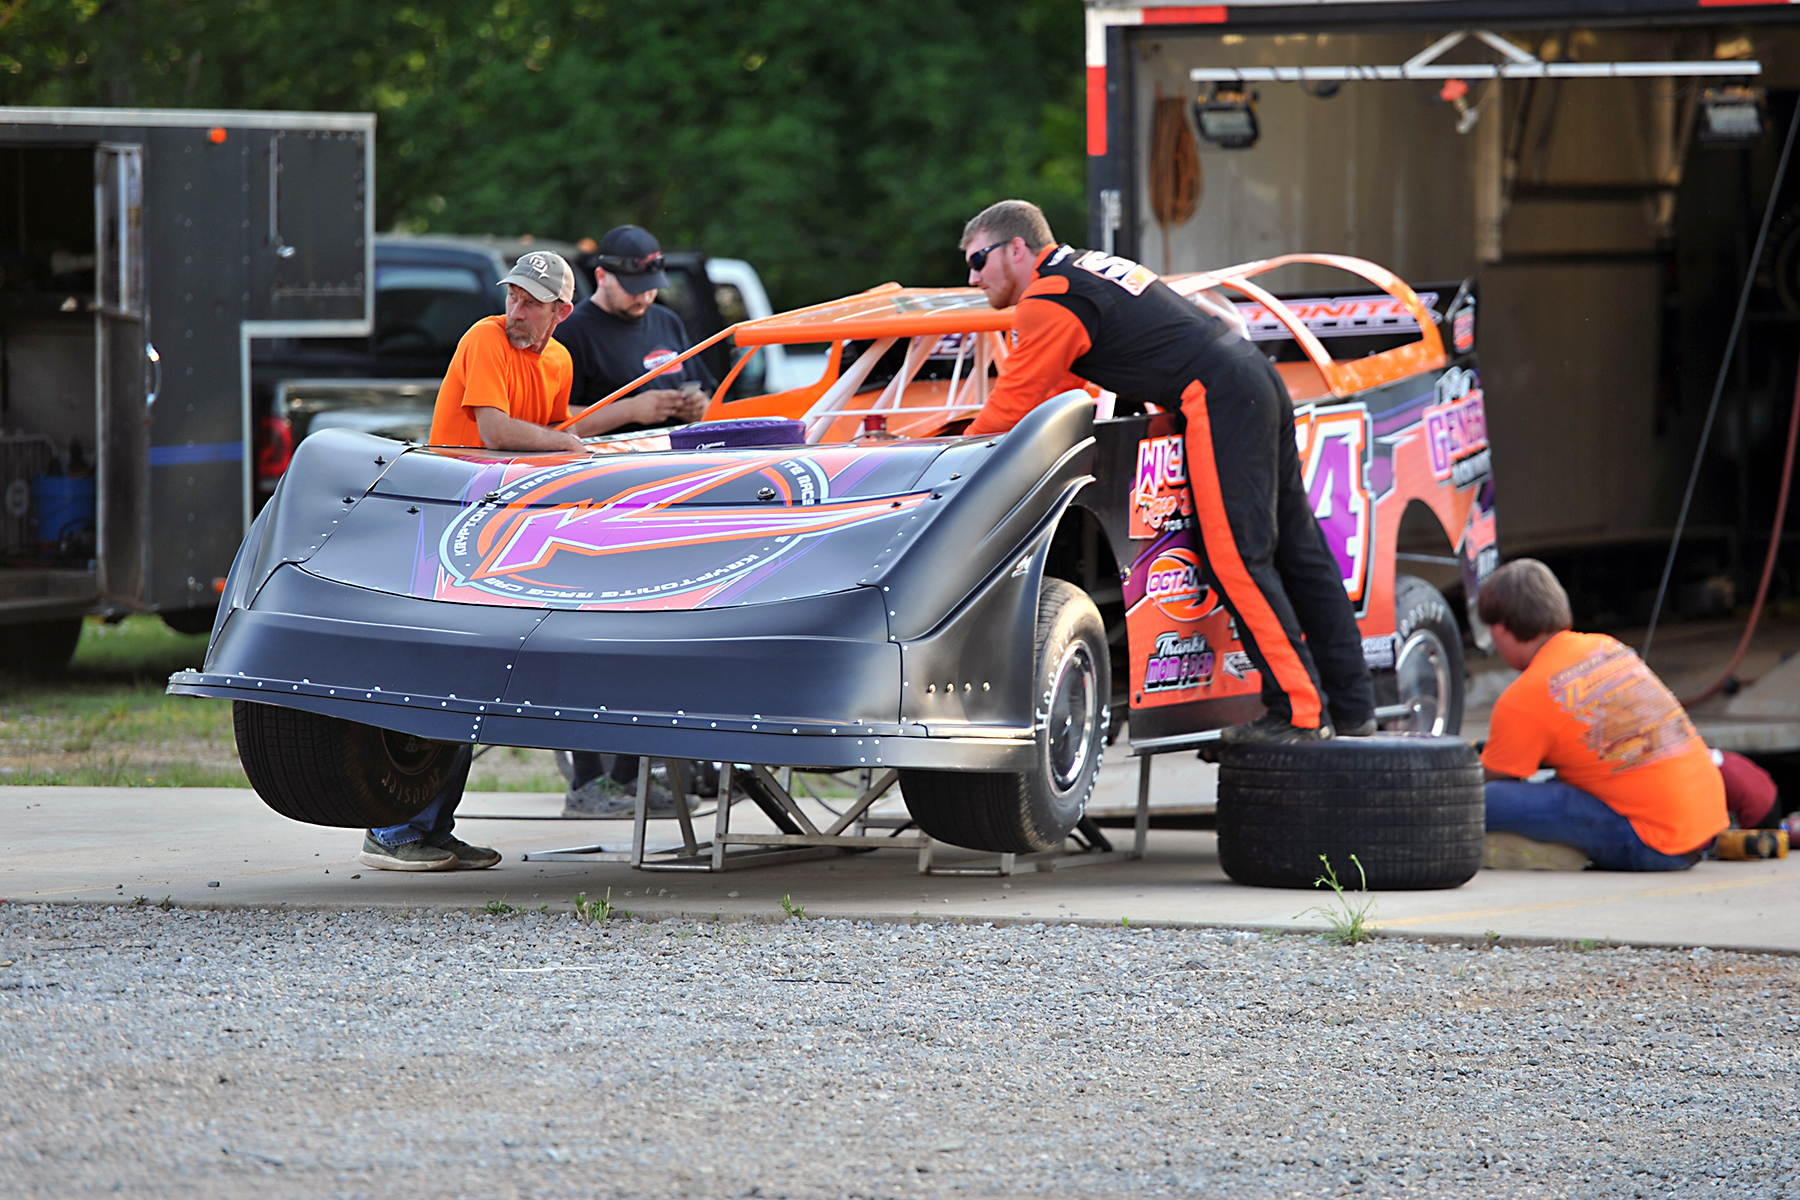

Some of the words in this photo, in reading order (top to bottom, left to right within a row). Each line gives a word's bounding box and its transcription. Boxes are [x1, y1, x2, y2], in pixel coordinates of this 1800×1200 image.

[519, 464, 584, 490] RACE
[600, 553, 760, 598] KRYPTONITE
[1147, 566, 1204, 597] OCTAN
[525, 588, 595, 599] RACE
[1400, 601, 1445, 637] OOSIER
[1156, 631, 1207, 657] Thanks
